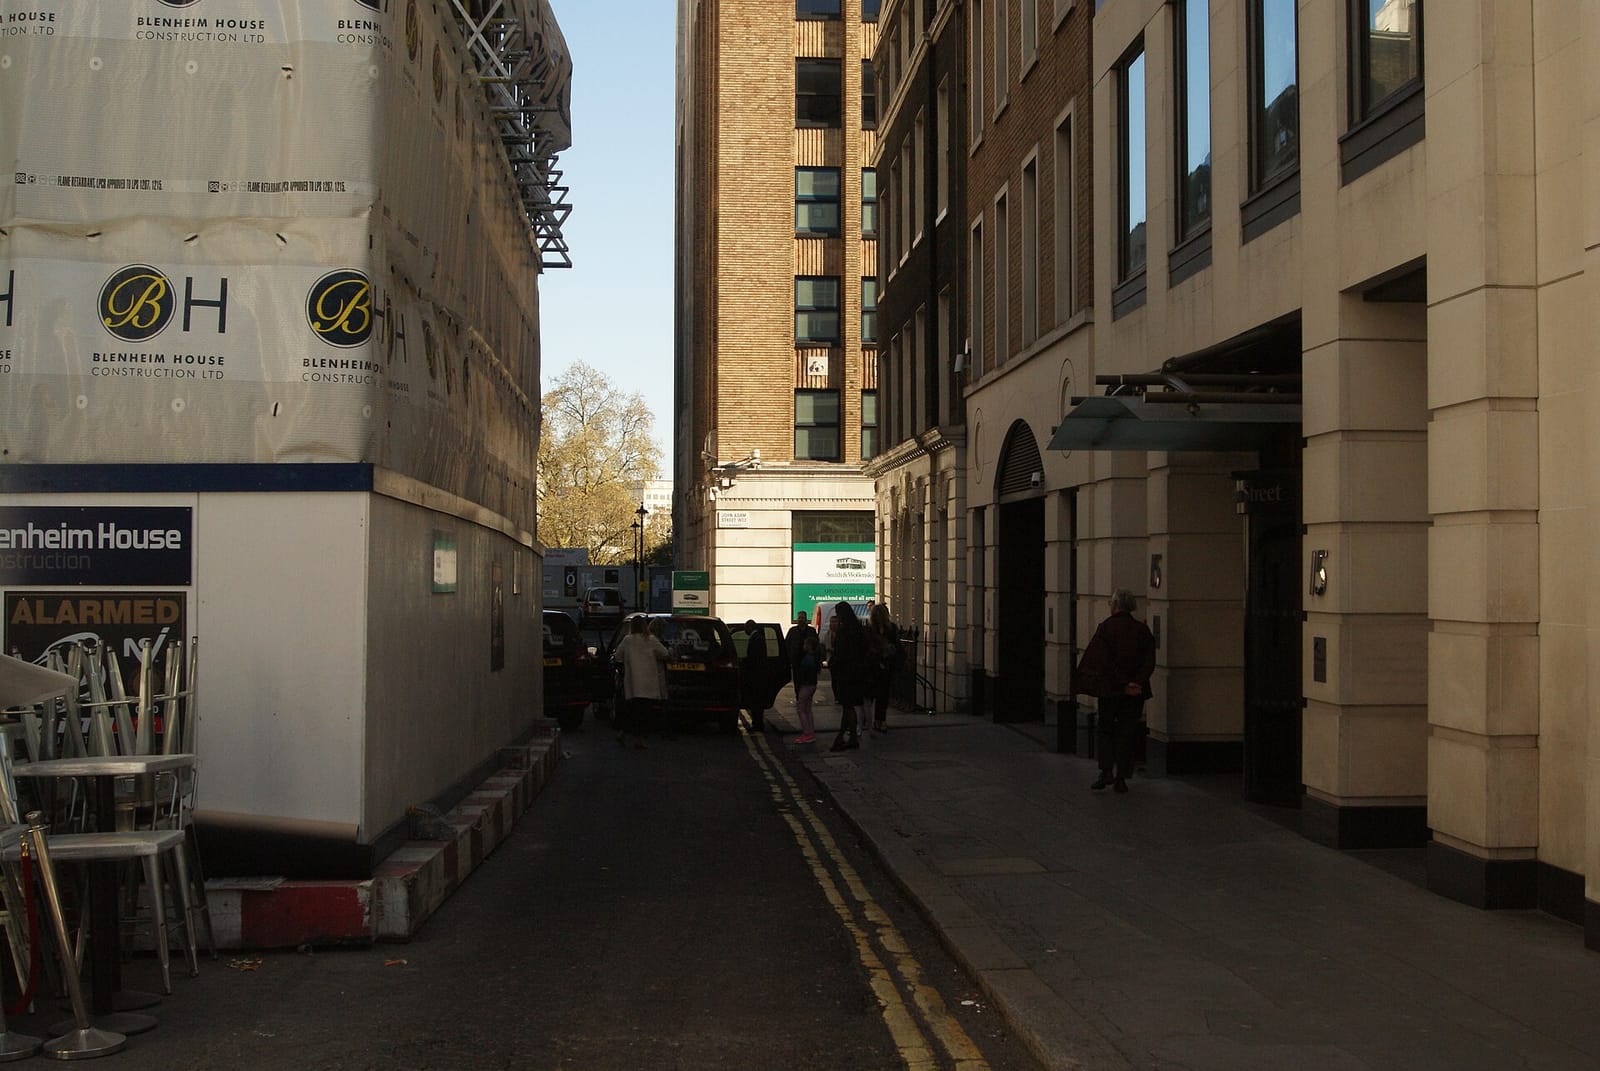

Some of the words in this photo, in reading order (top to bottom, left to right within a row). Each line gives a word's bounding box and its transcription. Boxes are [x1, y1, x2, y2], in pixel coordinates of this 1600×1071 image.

[9, 12, 56, 22] HOUSE
[137, 17, 208, 28] BLENHEIM
[215, 19, 265, 30] HOUSE
[33, 26, 55, 36] LTD
[136, 30, 237, 43] CONSTRUCTION
[243, 34, 265, 44] LTD
[93, 353, 165, 364] BLENHEIM
[173, 355, 225, 366] HOUSE
[91, 367, 195, 379] CONSTRUCTION
[201, 368, 224, 380] LTD
[0, 523, 93, 550] enheim
[98, 523, 182, 550] House
[11, 599, 180, 625] ALARMED
